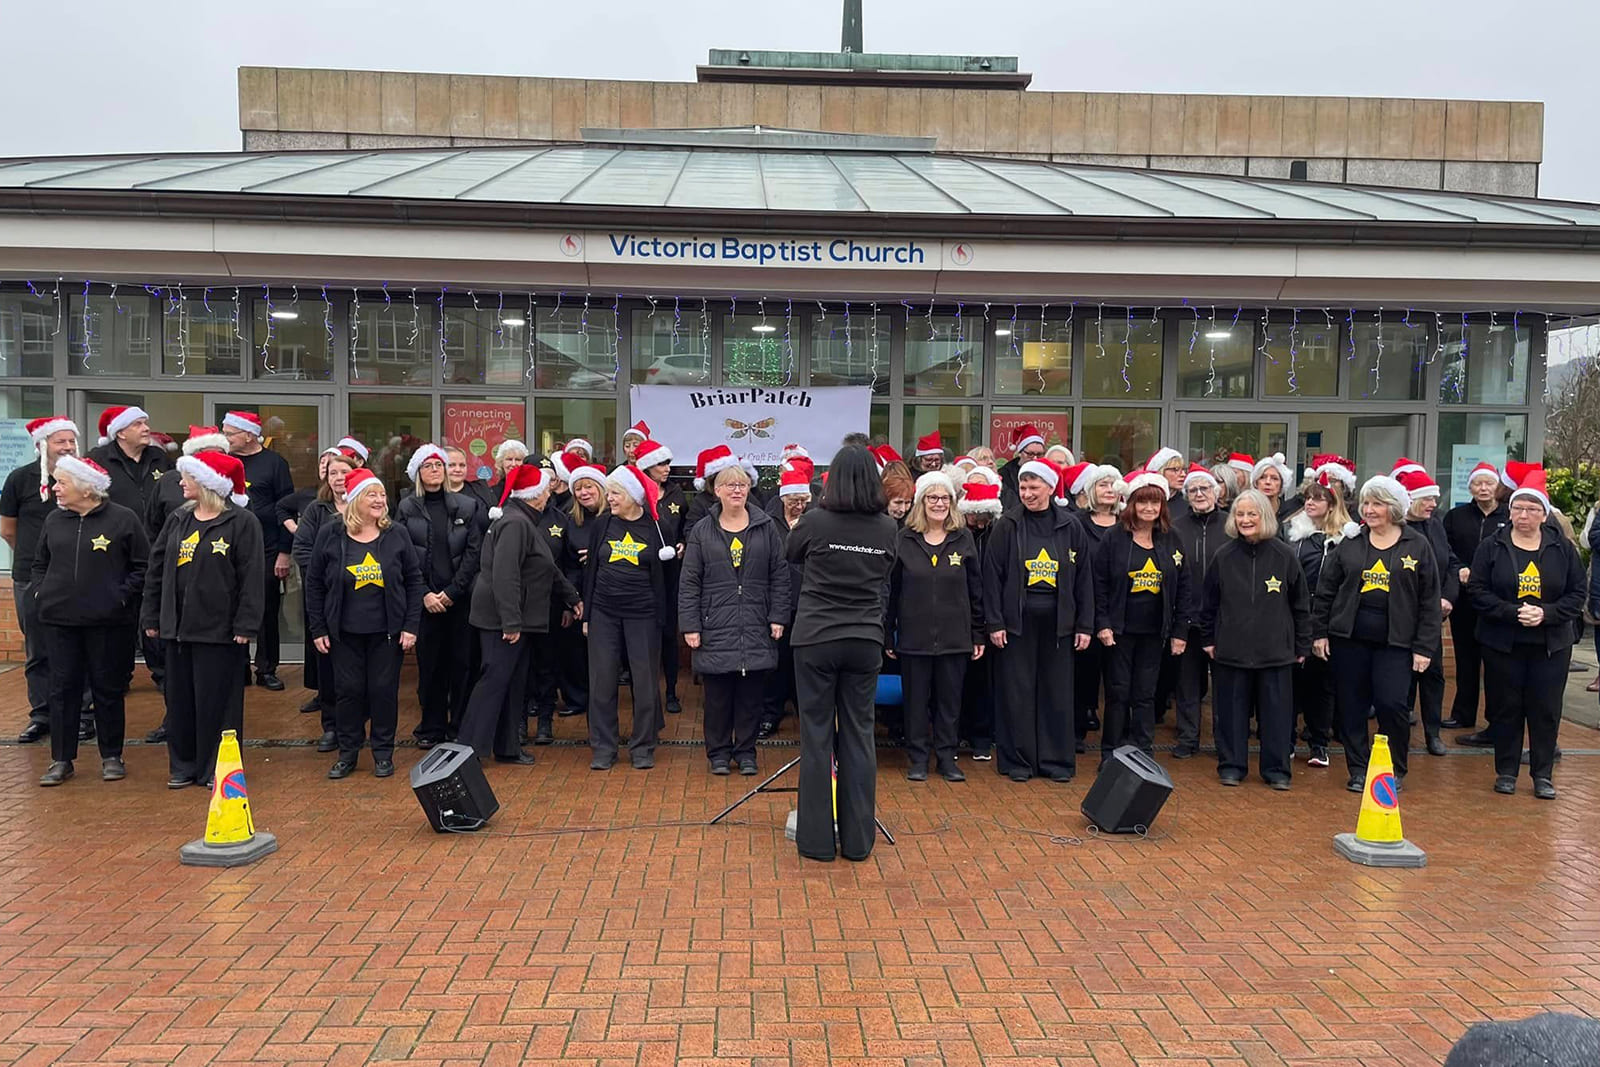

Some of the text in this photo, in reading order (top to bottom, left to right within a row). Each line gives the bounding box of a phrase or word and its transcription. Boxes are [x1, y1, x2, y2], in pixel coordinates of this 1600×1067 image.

[609, 233, 925, 265] Victoria Baptist Church
[690, 388, 812, 408] BriarPatch
[1031, 561, 1057, 570] ROCK
[1029, 569, 1057, 578] CHOIR
[1136, 571, 1163, 580] ROCK
